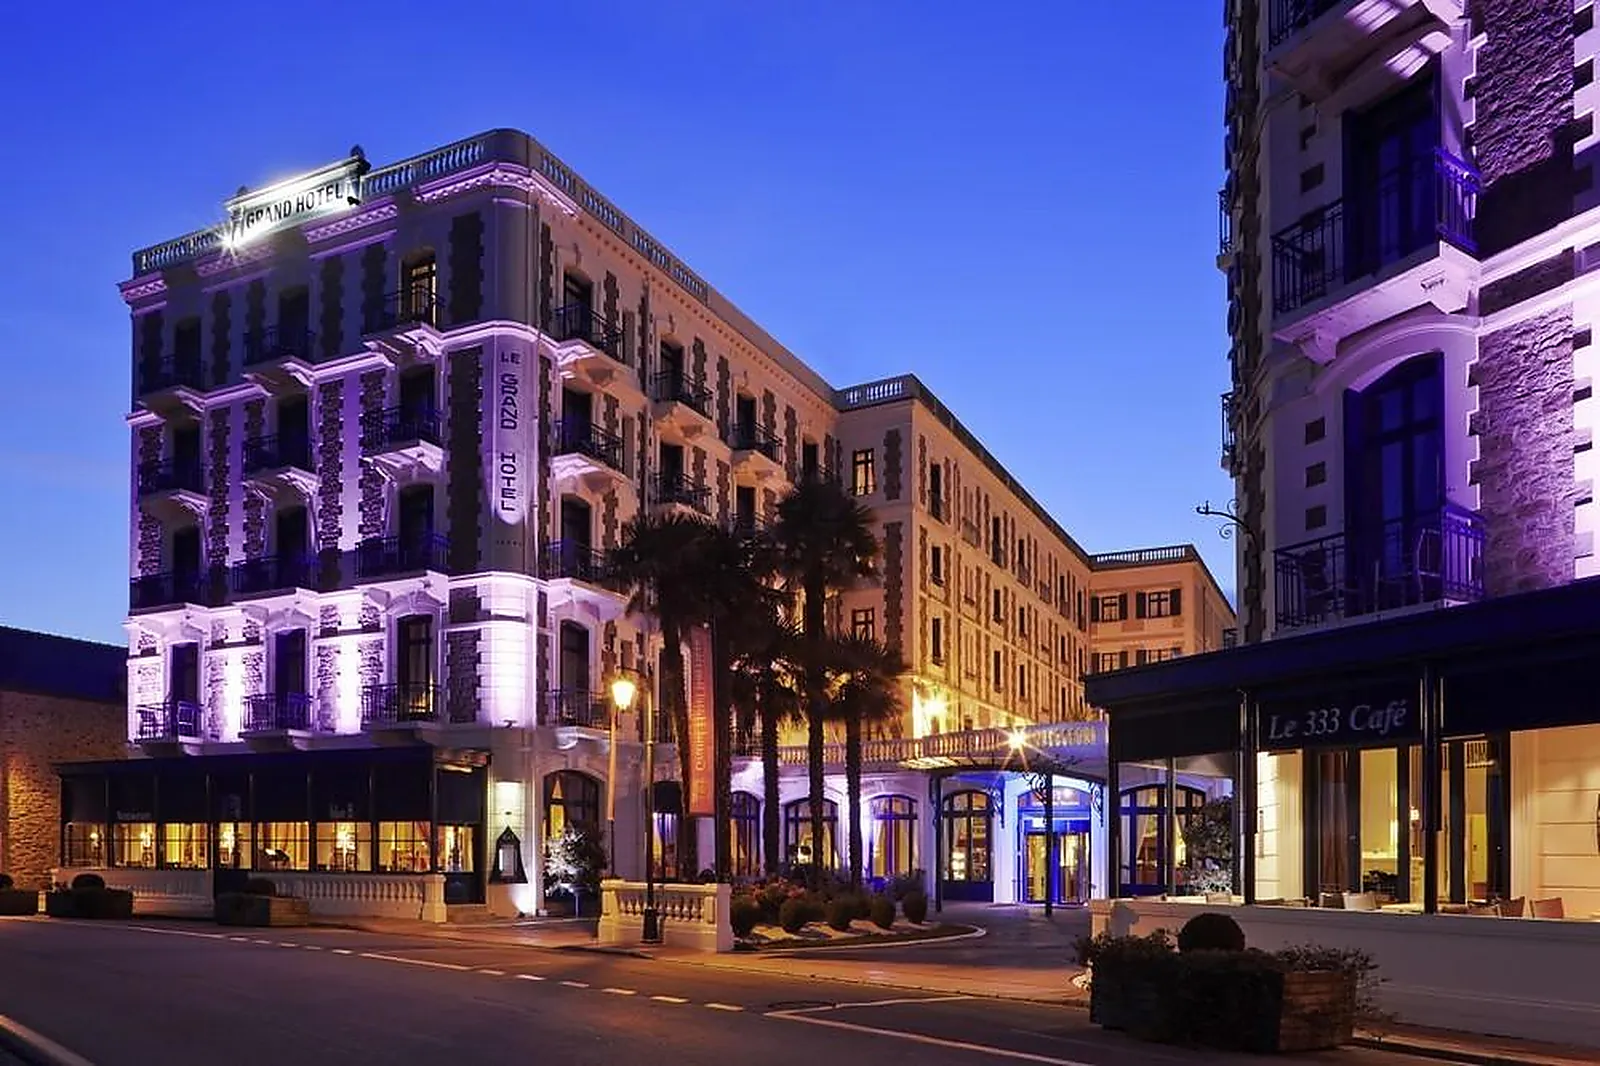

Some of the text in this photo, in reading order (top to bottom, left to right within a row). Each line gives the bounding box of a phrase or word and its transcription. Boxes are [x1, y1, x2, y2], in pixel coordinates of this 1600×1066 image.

[246, 183, 343, 228] GRAND HOTEL
[500, 351, 521, 512] LE GRAND HOTEL
[1268, 698, 1408, 739] Le 333 Café
